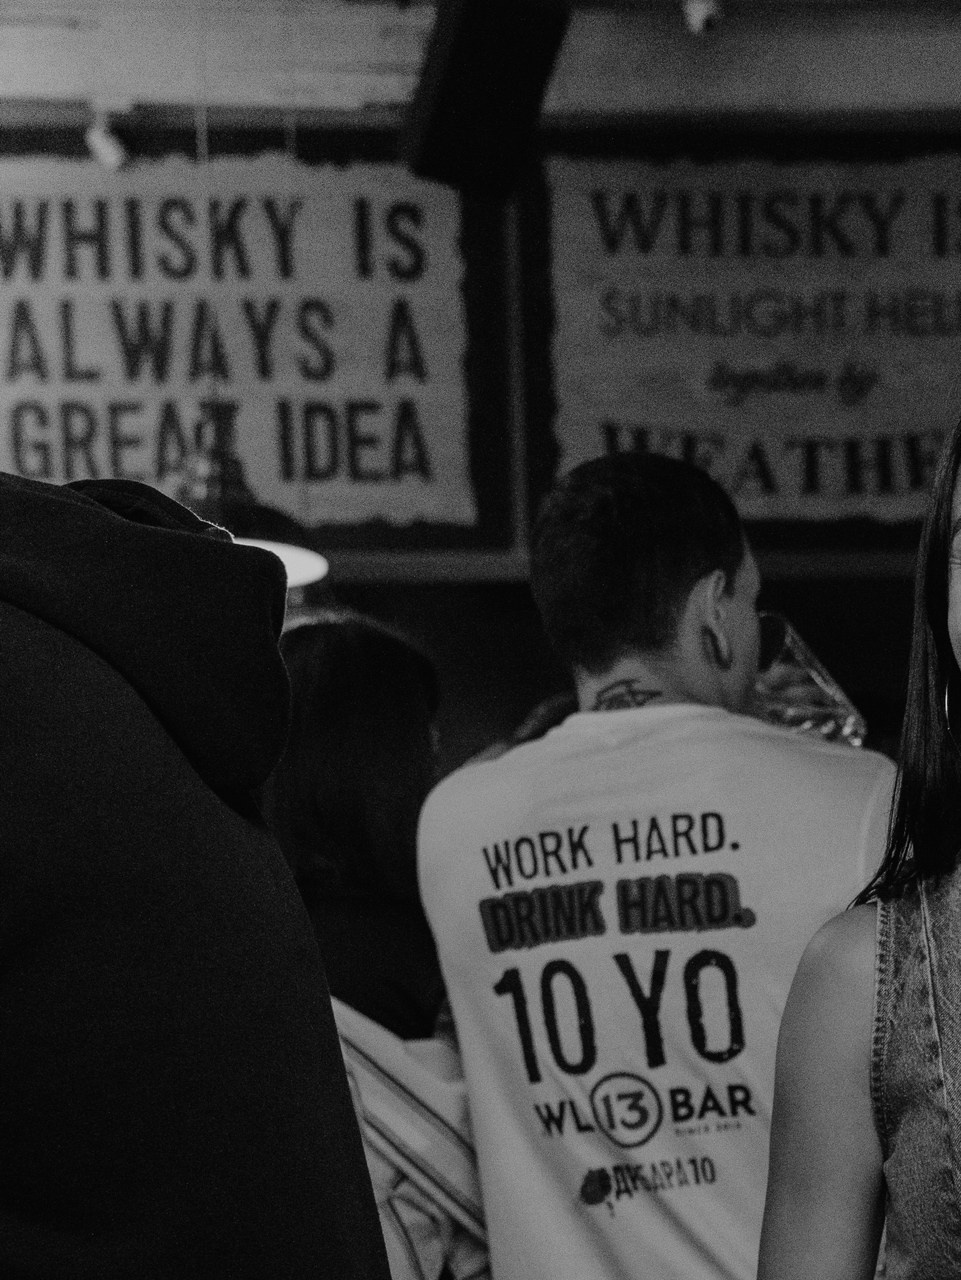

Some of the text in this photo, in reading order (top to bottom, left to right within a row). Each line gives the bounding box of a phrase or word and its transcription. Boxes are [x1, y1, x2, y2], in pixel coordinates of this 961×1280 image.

[0, 197, 426, 281] WHISKY IS
[591, 189, 904, 258] WHISKY
[6, 298, 430, 383] ALWAYS A
[277, 399, 432, 482] IDEA
[483, 811, 741, 890] WORK HARD.
[482, 873, 754, 952] DRINK HARD.
[492, 949, 746, 1084] 10 YO
[668, 1084, 757, 1123] BAR
